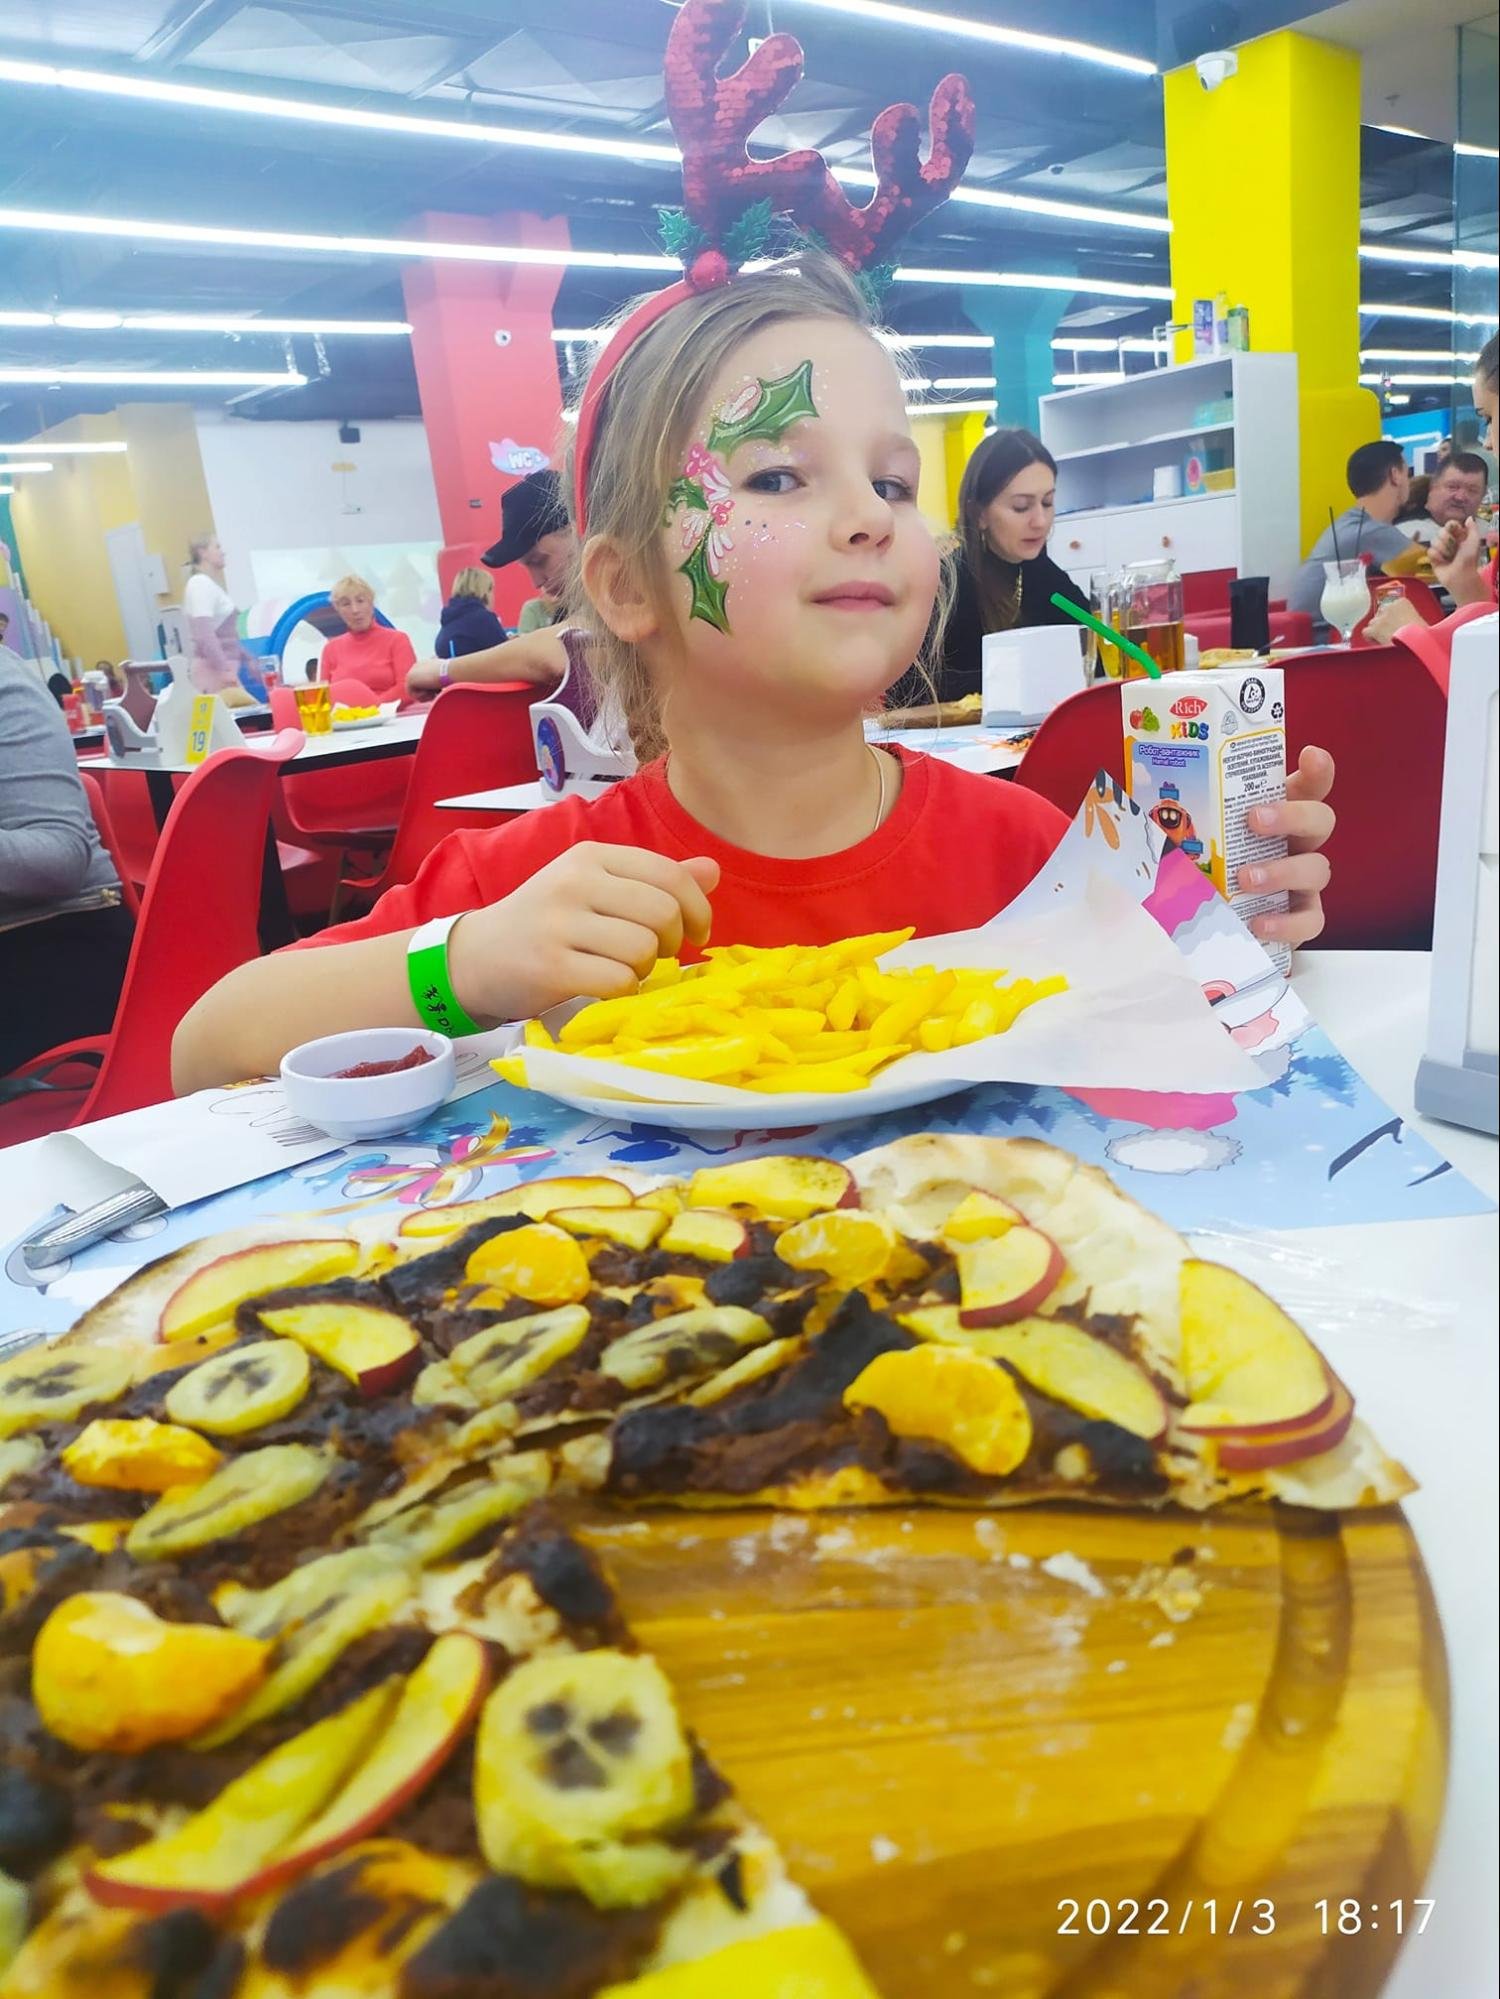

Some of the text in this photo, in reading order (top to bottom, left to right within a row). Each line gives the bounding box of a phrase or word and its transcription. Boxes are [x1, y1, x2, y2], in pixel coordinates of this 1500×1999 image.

[508, 451, 533, 469] WC
[1175, 701, 1202, 714] Rich
[193, 731, 205, 752] 19
[1244, 782, 1255, 792] 200
